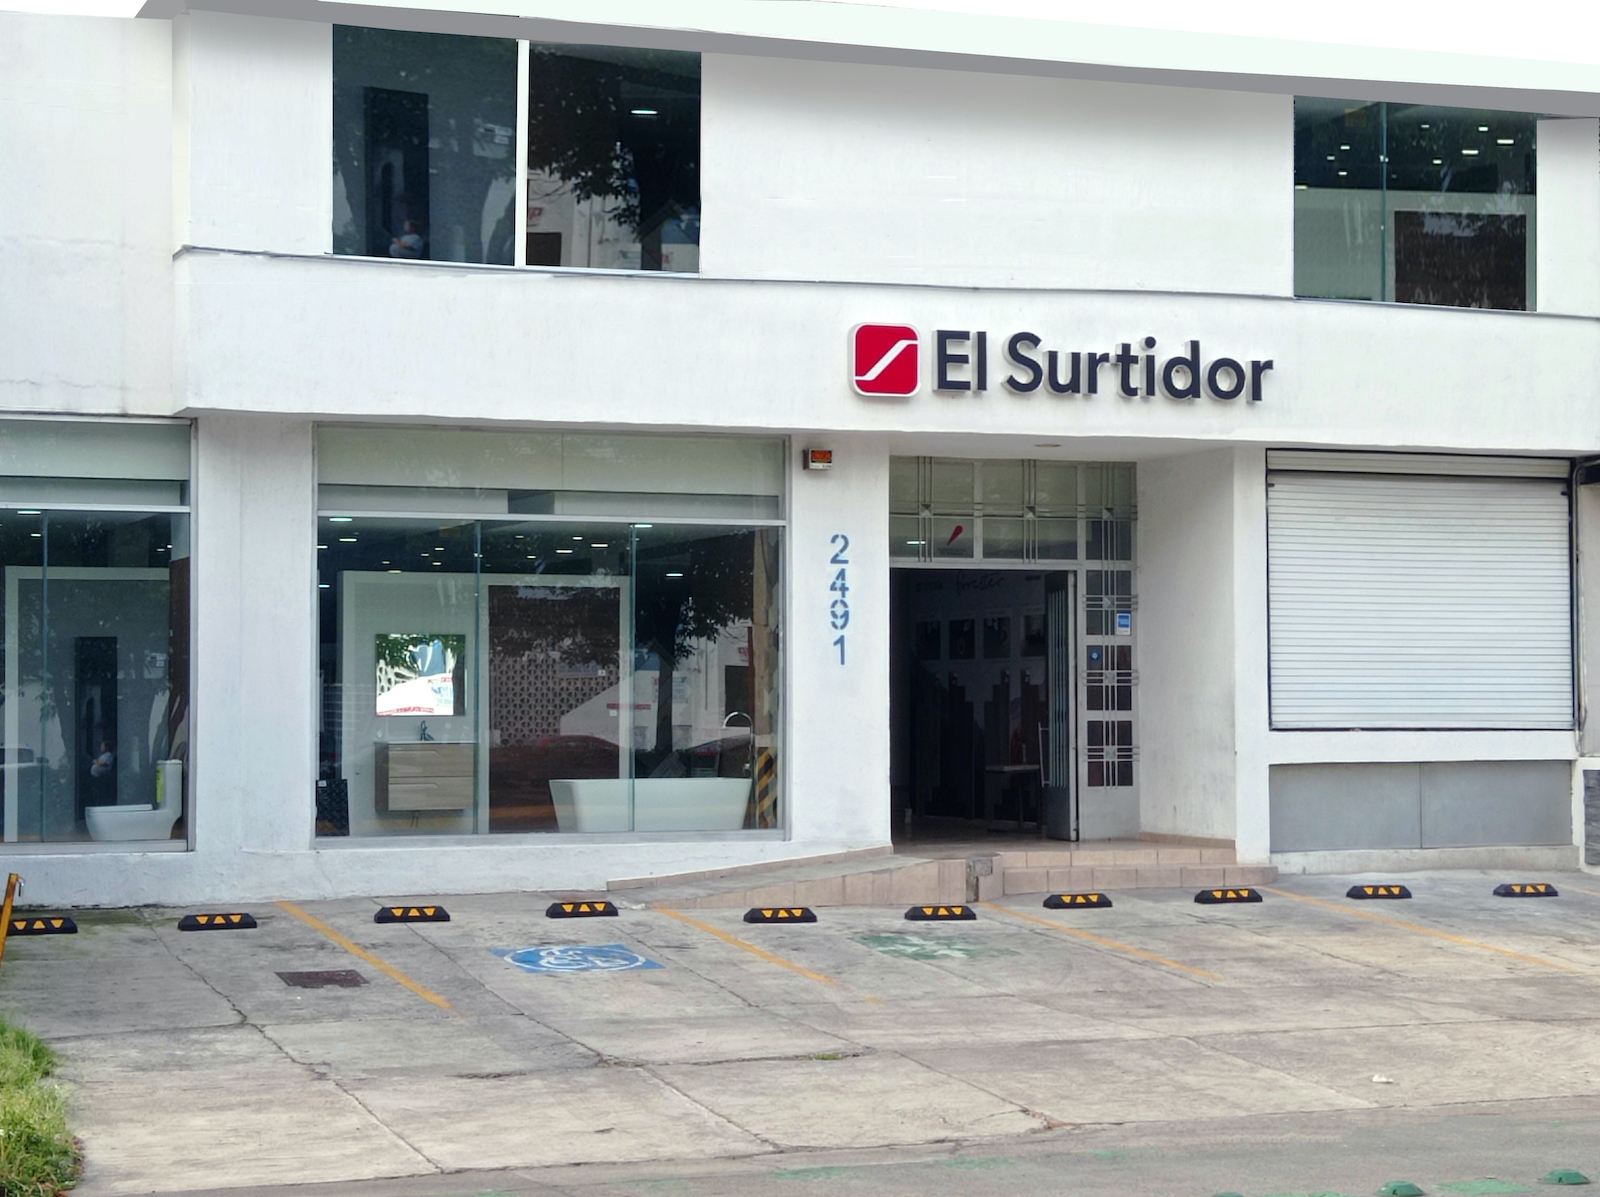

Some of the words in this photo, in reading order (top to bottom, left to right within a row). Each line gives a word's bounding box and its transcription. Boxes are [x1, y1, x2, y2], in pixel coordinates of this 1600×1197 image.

[935, 330, 987, 391] El
[1005, 331, 1273, 402] Surtidor
[829, 533, 849, 665] 2491
